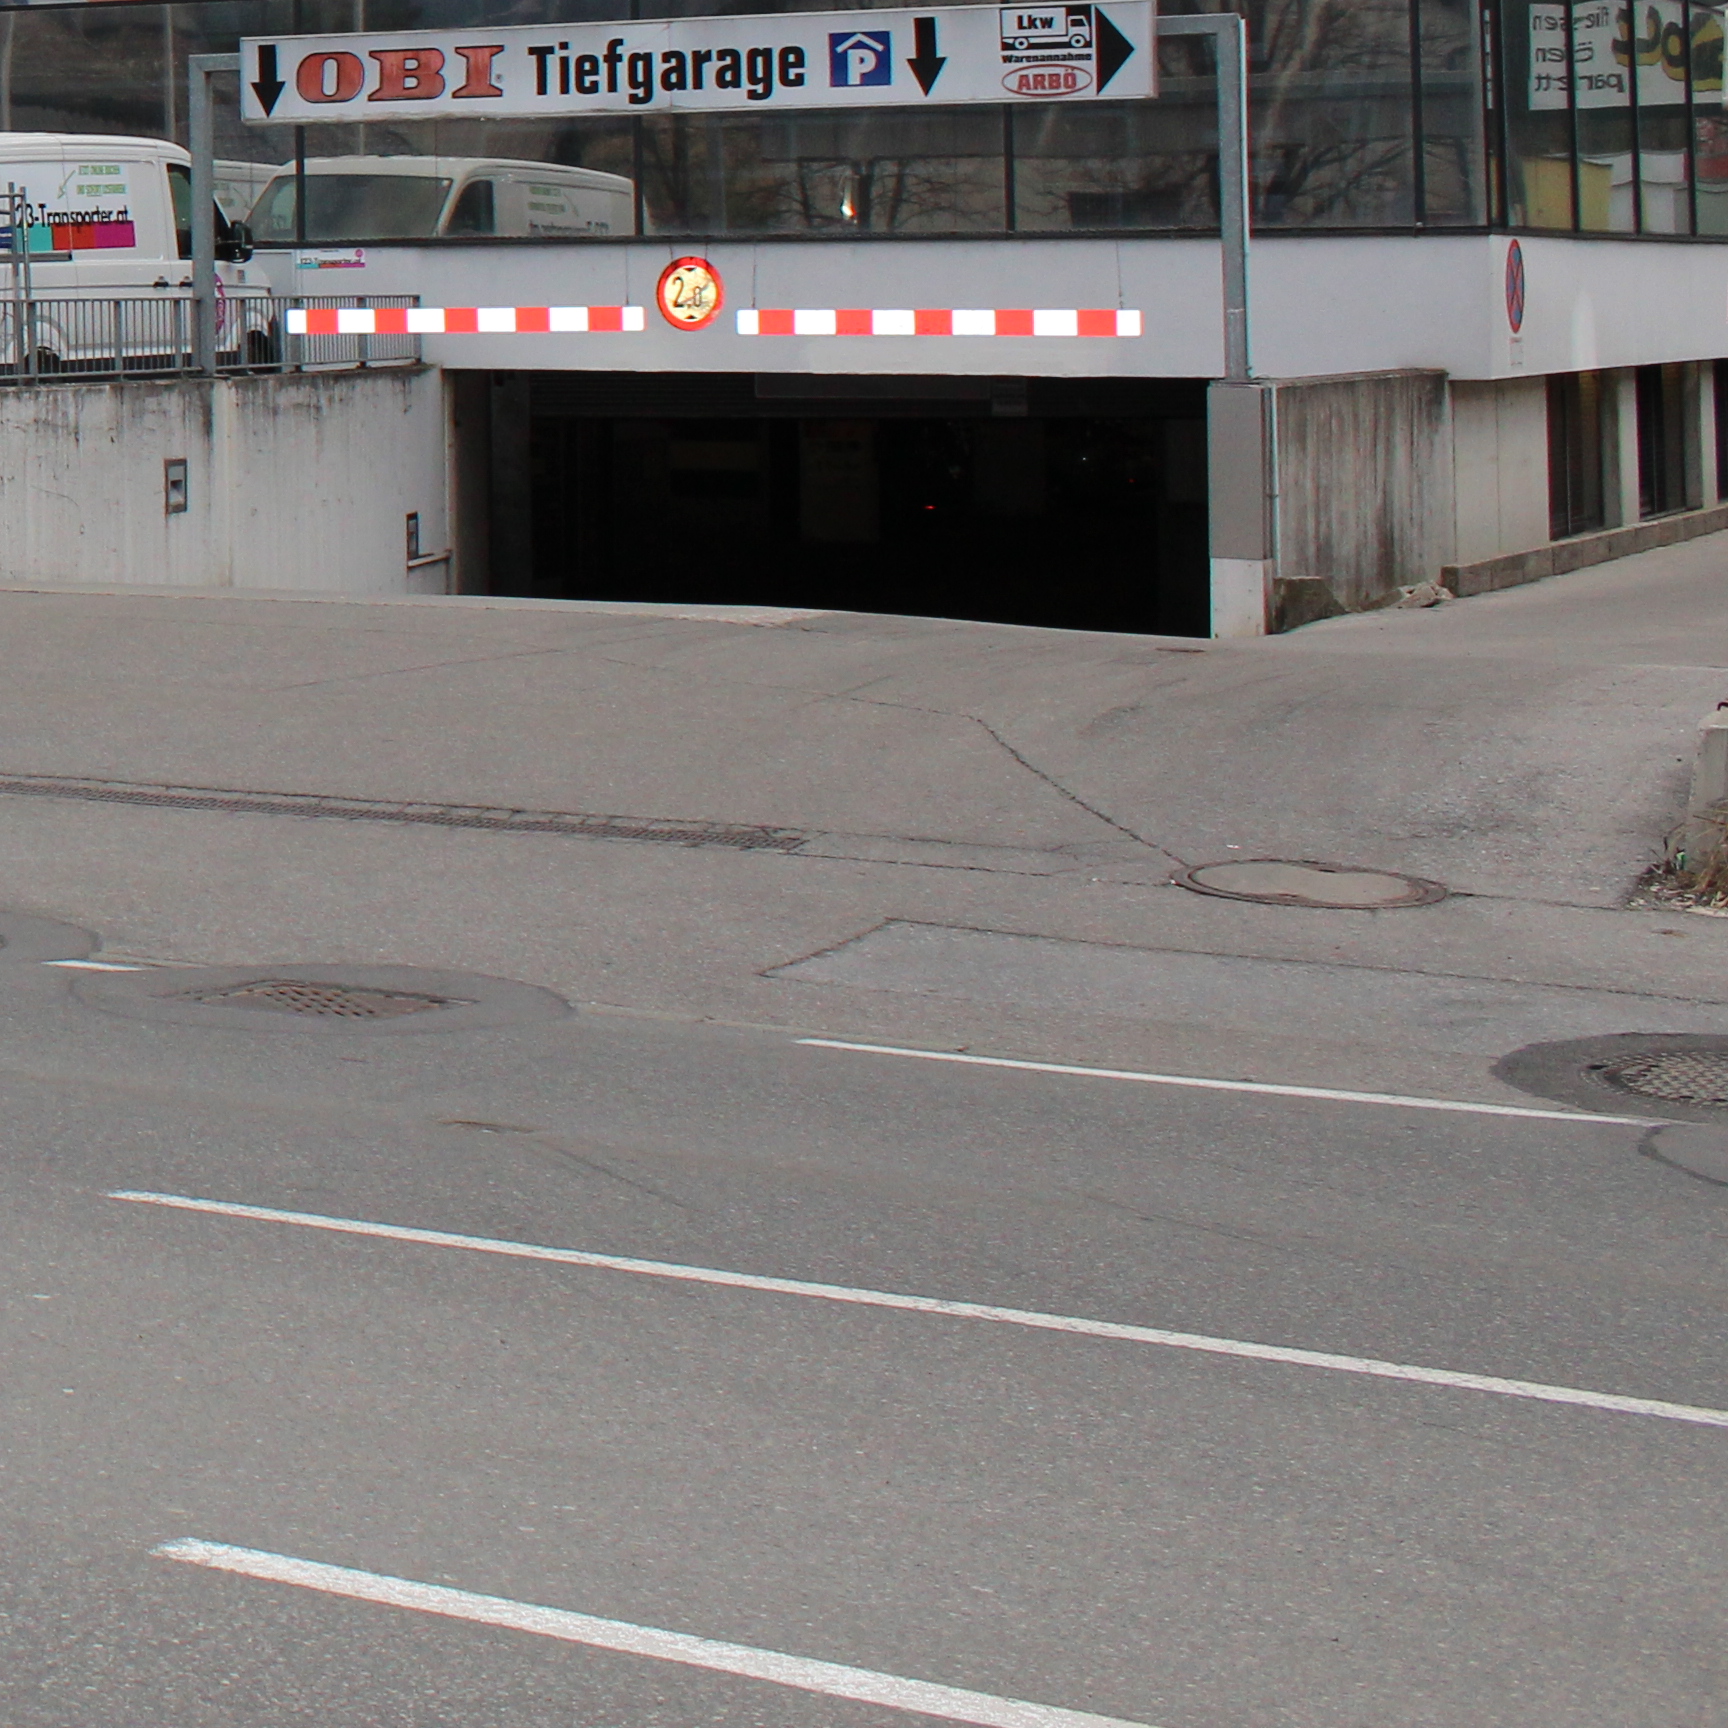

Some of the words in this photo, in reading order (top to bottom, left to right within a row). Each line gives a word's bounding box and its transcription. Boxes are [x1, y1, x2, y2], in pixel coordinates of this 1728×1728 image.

[1017, 14, 1054, 30] Lkw
[1001, 51, 1093, 63] Warenannahme
[296, 45, 505, 103] OBI
[528, 38, 806, 104] Tiefgarage
[1017, 68, 1078, 91] ARBÖ
[14, 203, 129, 231] 23-Transporter.at
